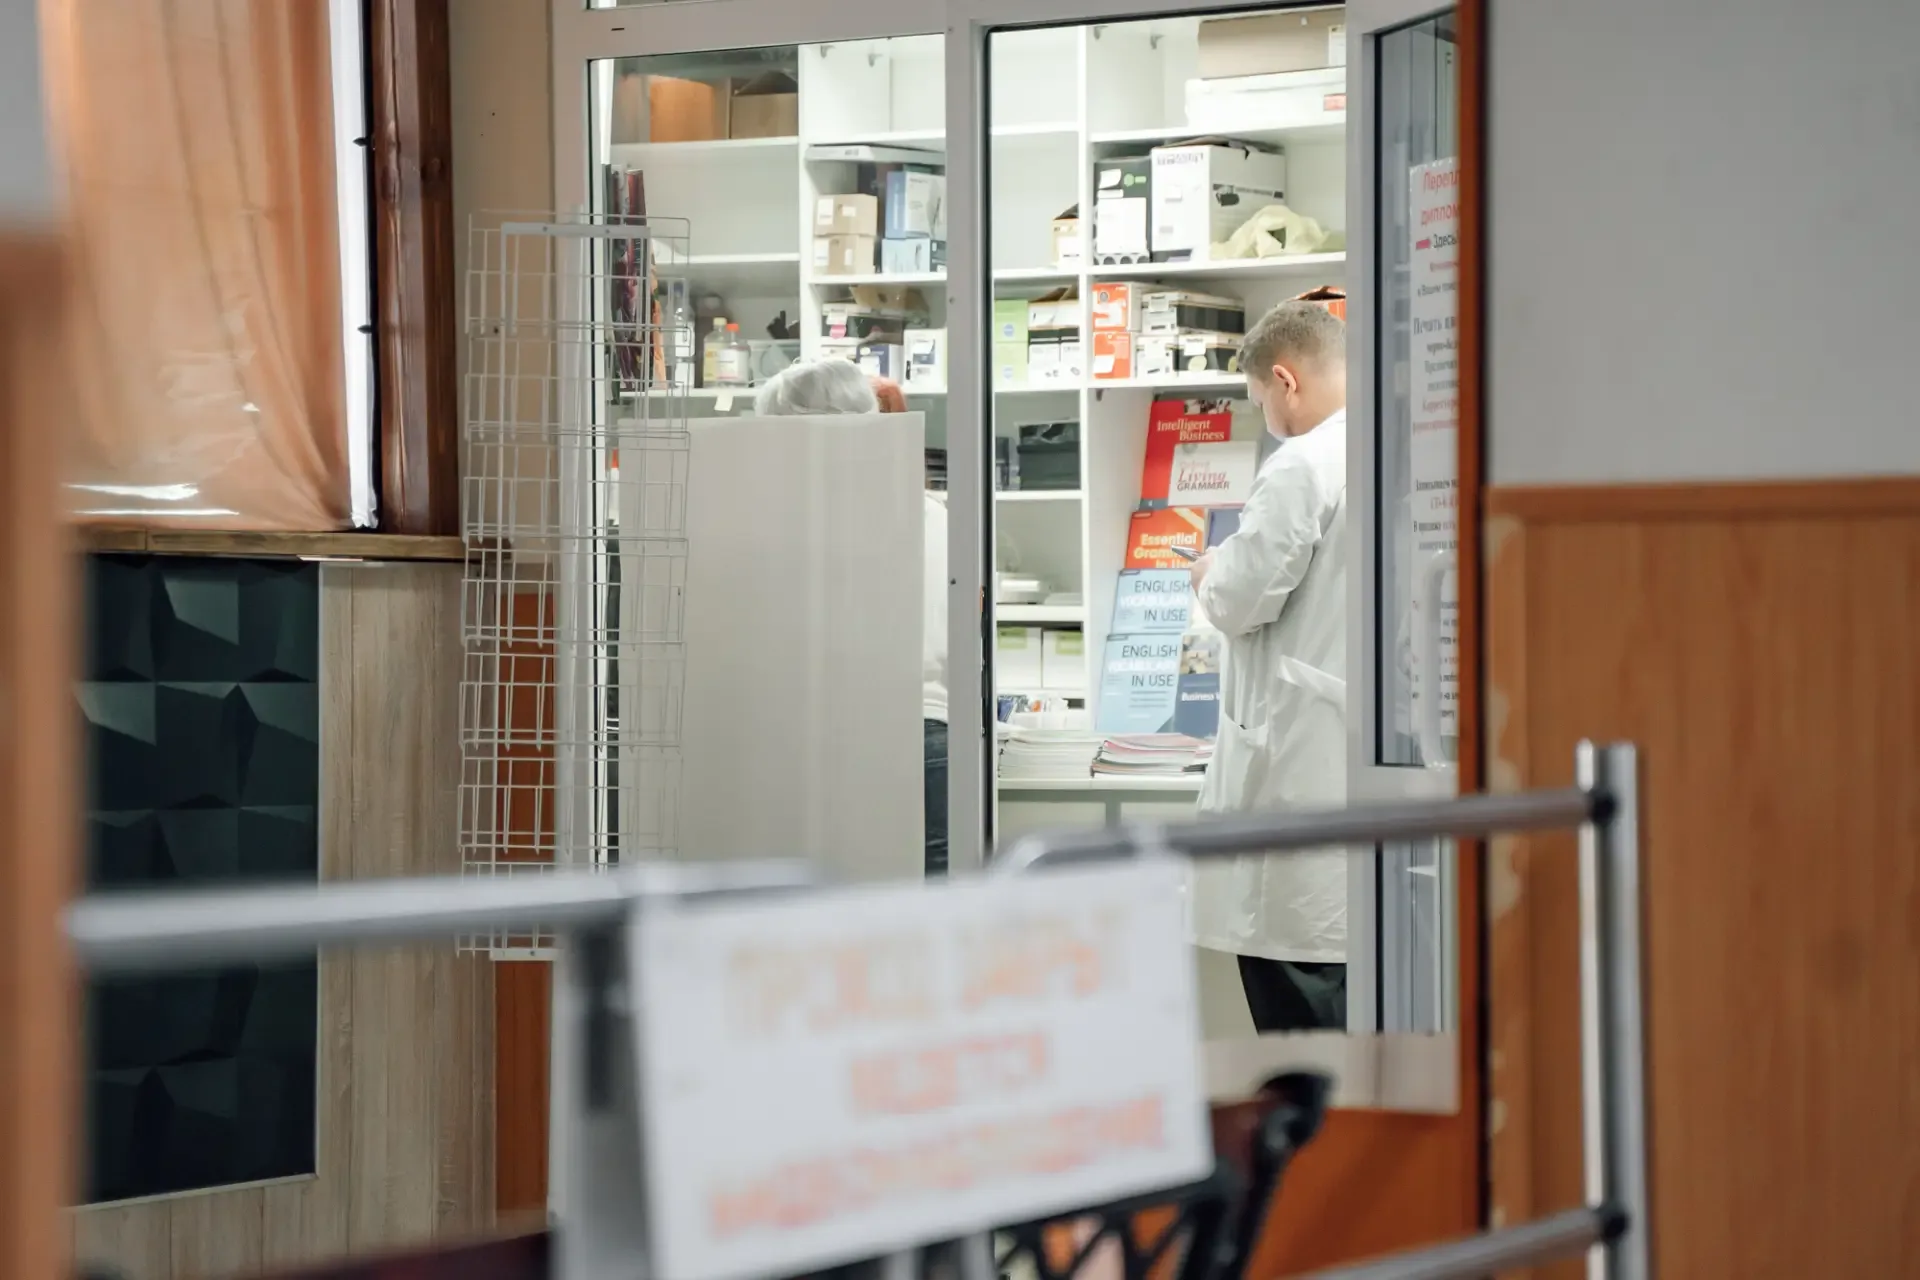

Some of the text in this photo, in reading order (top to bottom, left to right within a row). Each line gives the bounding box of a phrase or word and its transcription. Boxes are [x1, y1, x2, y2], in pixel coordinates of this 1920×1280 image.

[1157, 418, 1211, 432] Intelligent
[1180, 429, 1225, 441] Business
[1176, 481, 1230, 492] GRAMMAR
[1140, 532, 1198, 546] Essential
[1134, 580, 1191, 593] ENGLISH
[1144, 608, 1157, 621] IN
[1161, 608, 1188, 621] USE
[1122, 645, 1178, 658] ENGLISH
[1131, 674, 1144, 687] IN
[1148, 674, 1174, 687] USE
[1181, 691, 1214, 701] Business
